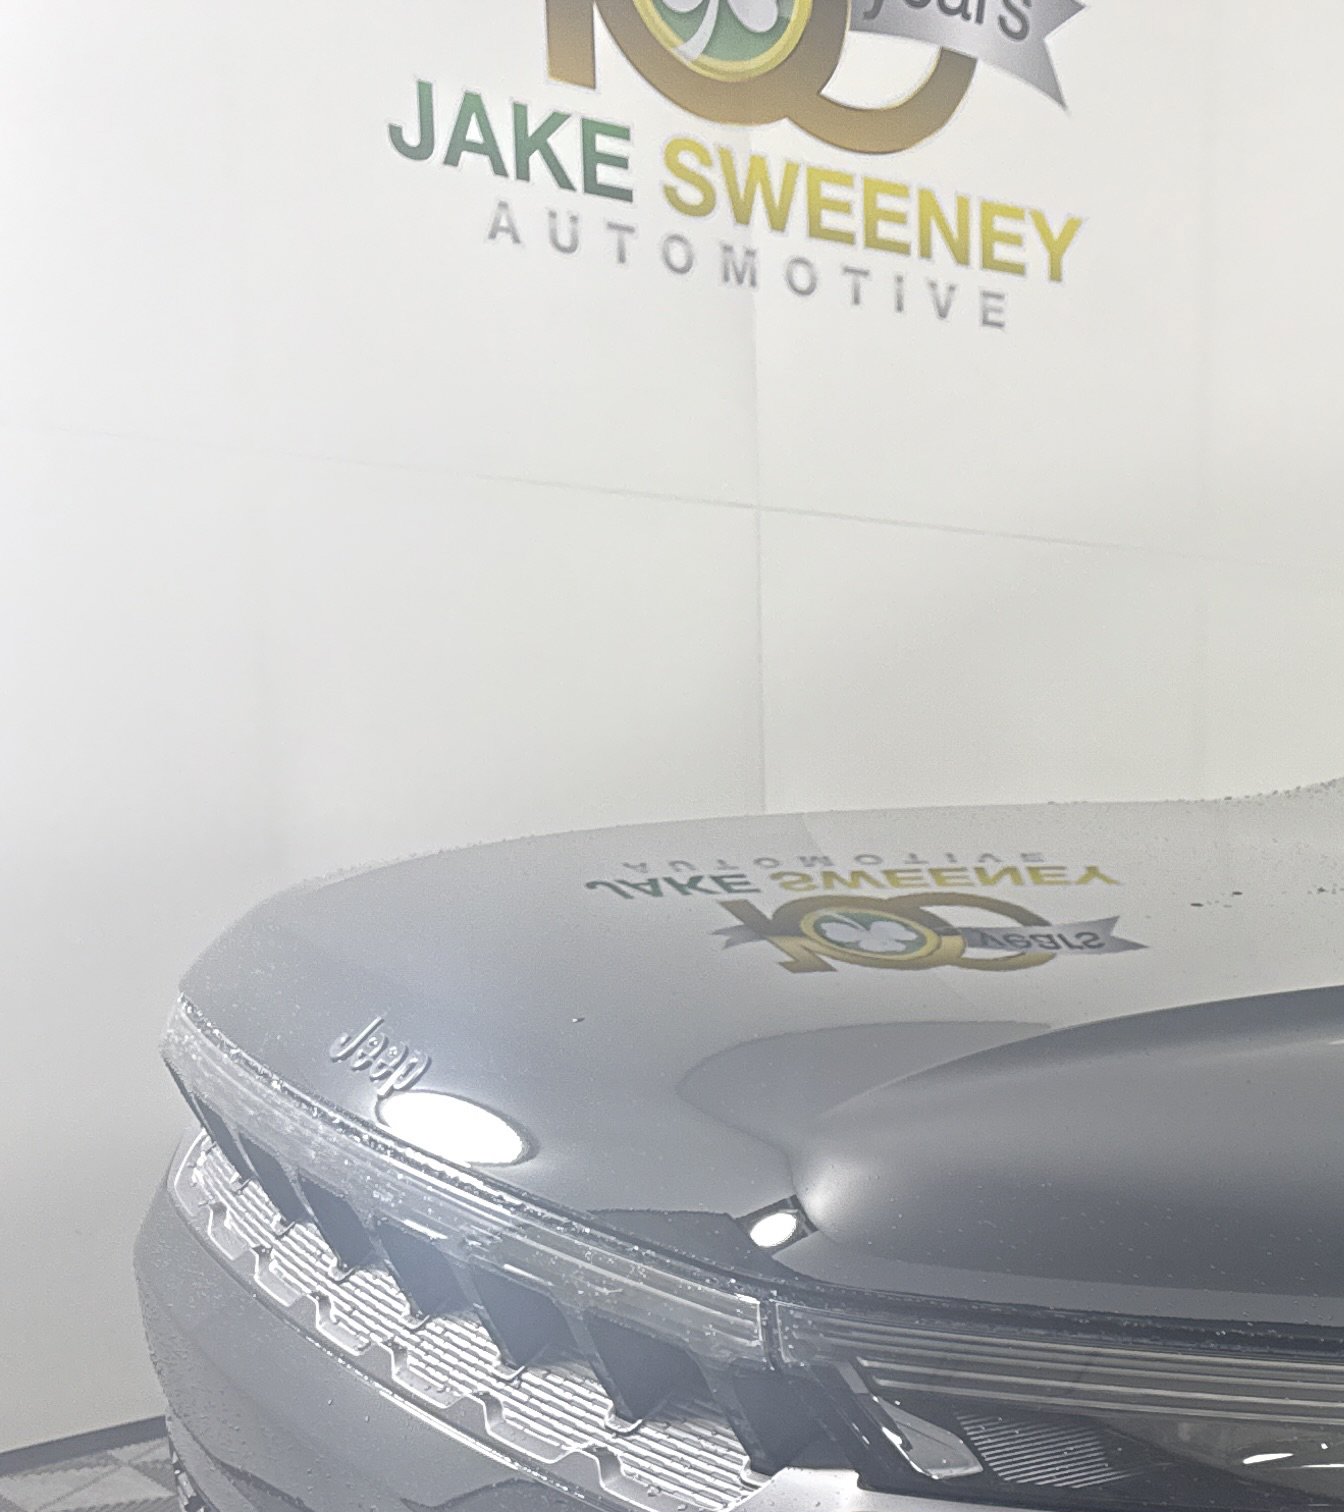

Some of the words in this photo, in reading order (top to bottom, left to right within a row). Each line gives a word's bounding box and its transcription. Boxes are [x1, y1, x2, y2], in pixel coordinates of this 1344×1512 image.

[388, 79, 634, 203] JAKE
[662, 137, 1083, 284] SWEENEY
[487, 201, 1007, 329] AUTOMOTIVE
[329, 1015, 432, 1100] Jeep
